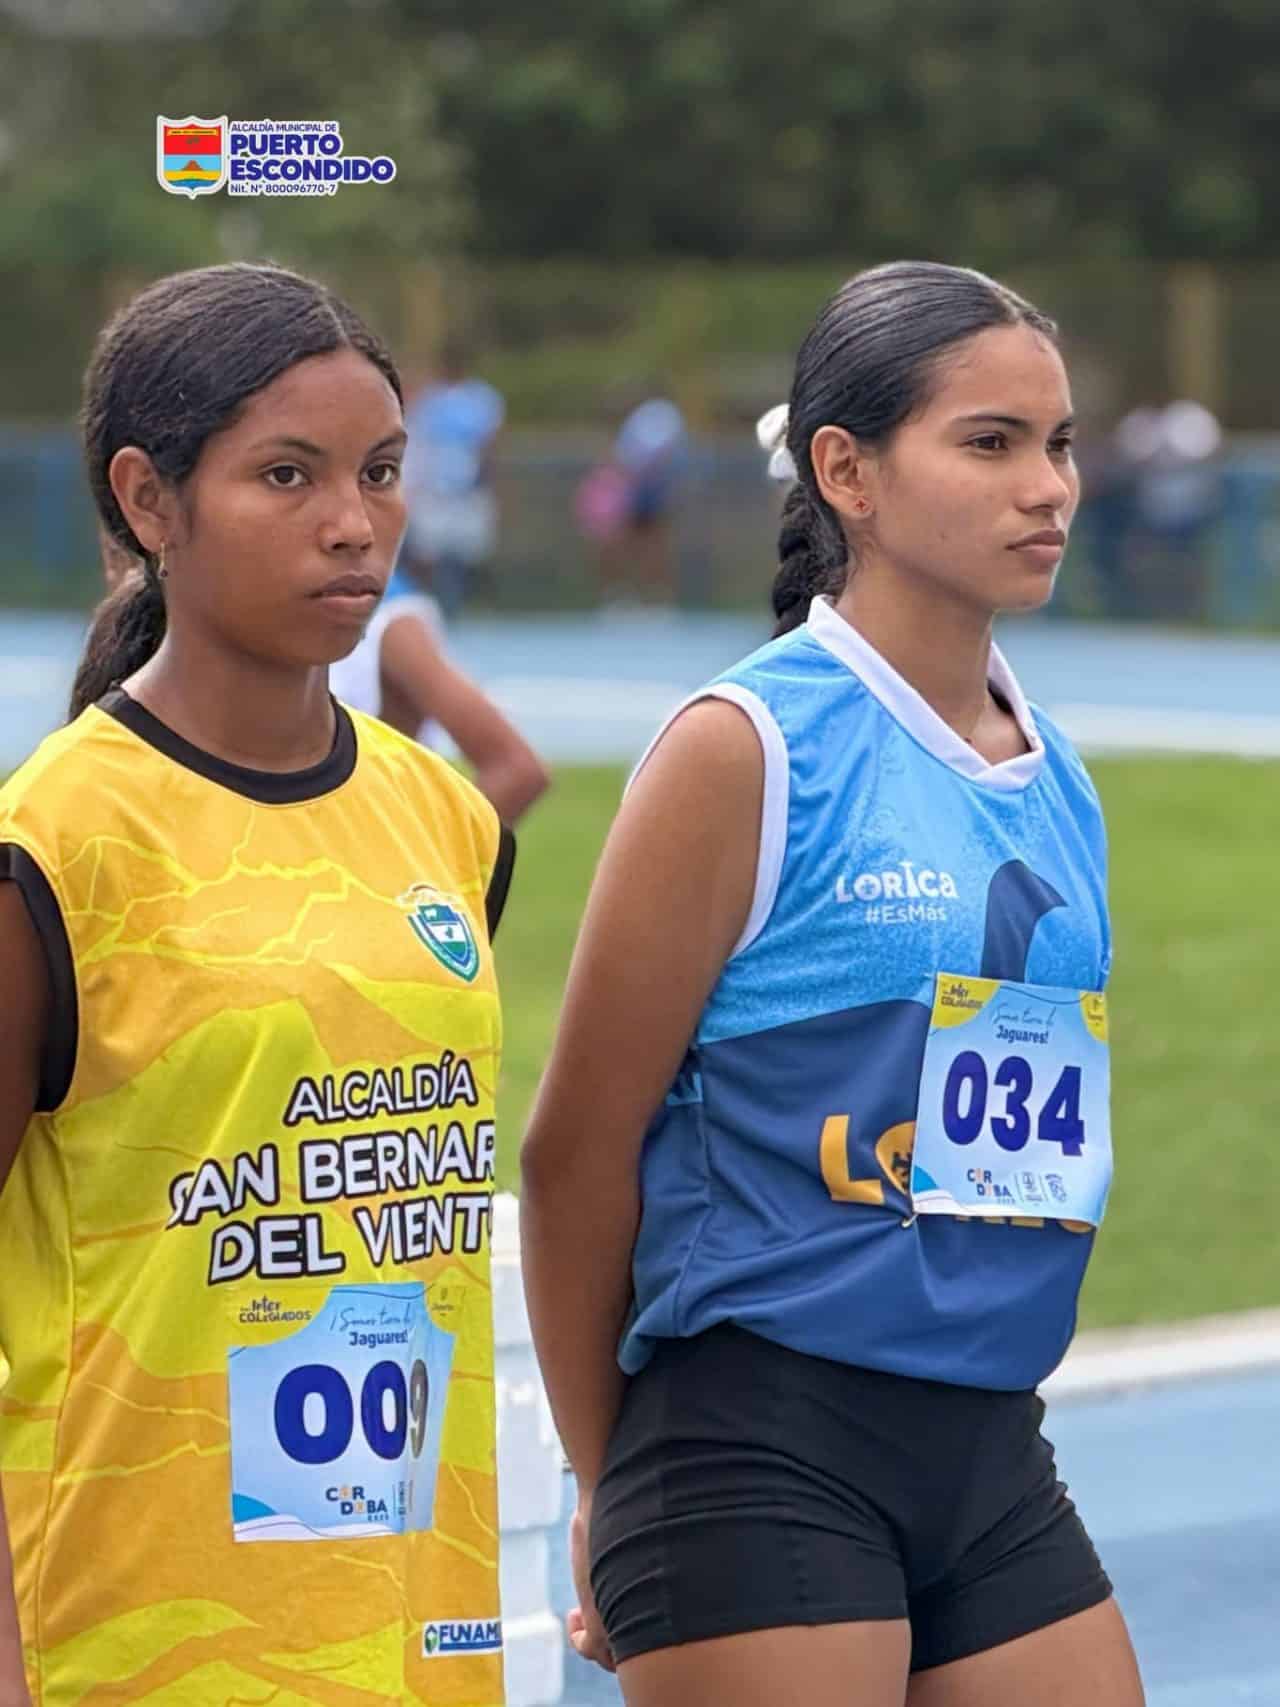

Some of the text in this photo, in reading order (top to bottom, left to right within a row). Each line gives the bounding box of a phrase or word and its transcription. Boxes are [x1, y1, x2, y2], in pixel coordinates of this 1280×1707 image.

[995, 1024, 1049, 1045] Jaguares!
[282, 1050, 479, 1126] ALCALDÍA
[942, 1049, 1086, 1157] 034
[207, 1191, 493, 1287] DEL VIENT
[239, 1310, 313, 1324] COLEGIADOS
[348, 1329, 409, 1349] Jaguares!
[273, 1359, 430, 1465] 009
